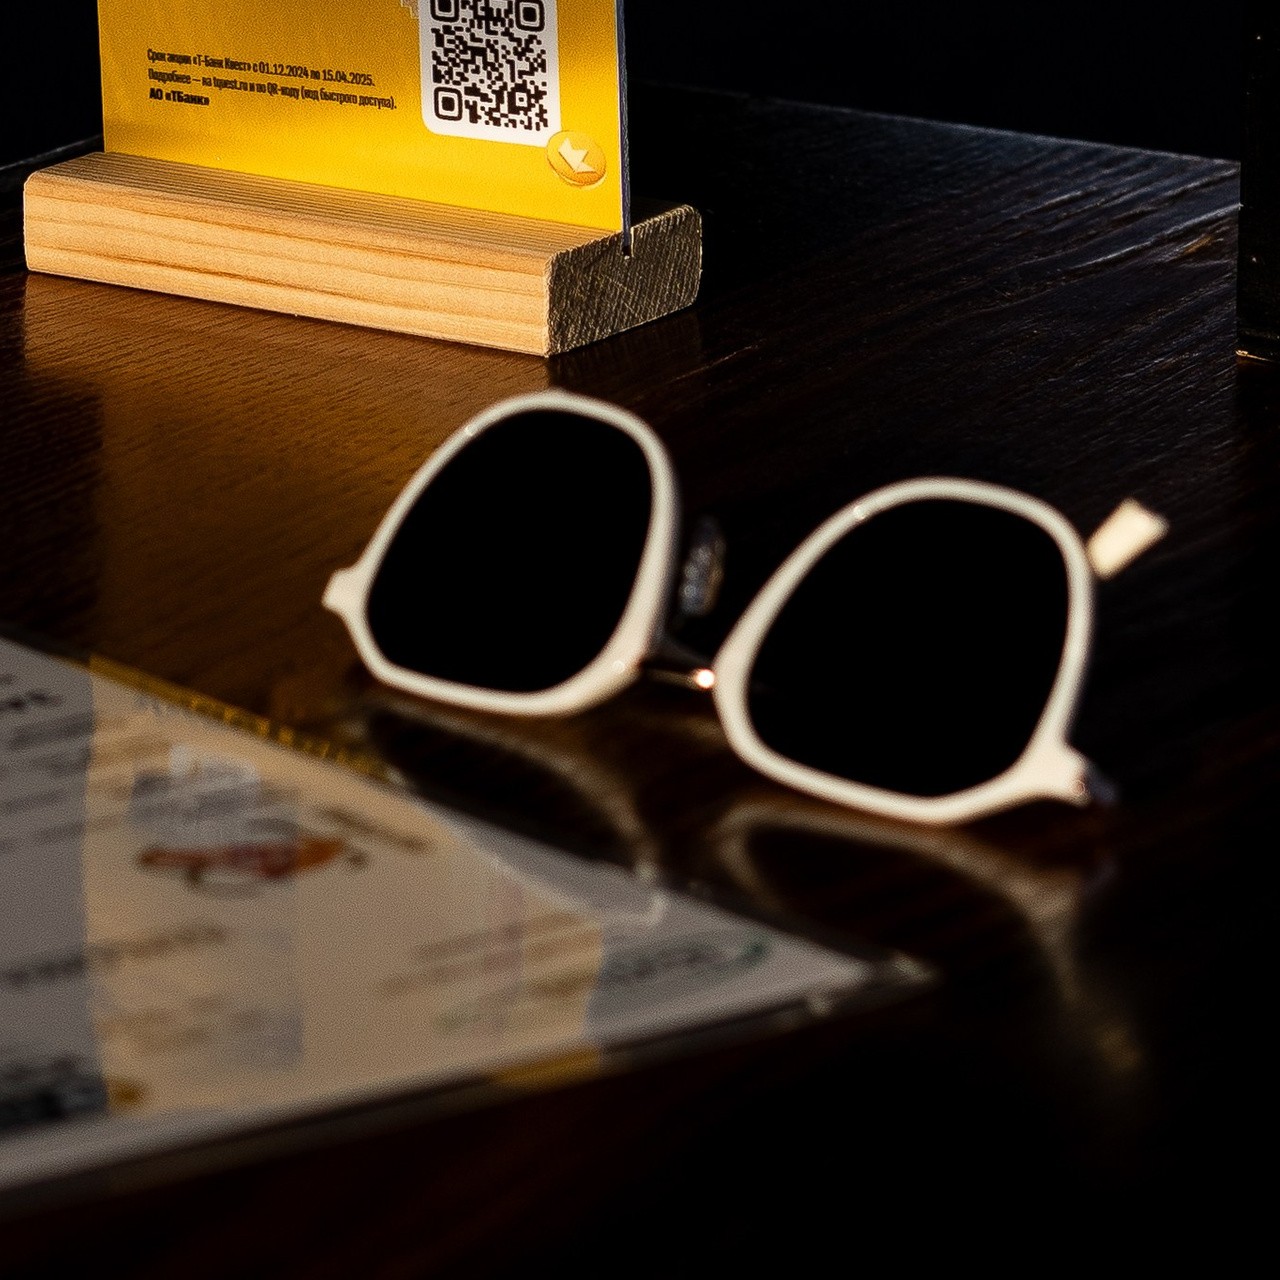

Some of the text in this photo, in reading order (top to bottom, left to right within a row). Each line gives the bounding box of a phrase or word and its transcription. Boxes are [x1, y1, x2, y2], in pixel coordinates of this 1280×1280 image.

[259, 61, 309, 79] 01.12.2024
[322, 69, 375, 86] 15.04.2025.
[149, 88, 163, 100] АО
[320, 88, 357, 105] быстрого
